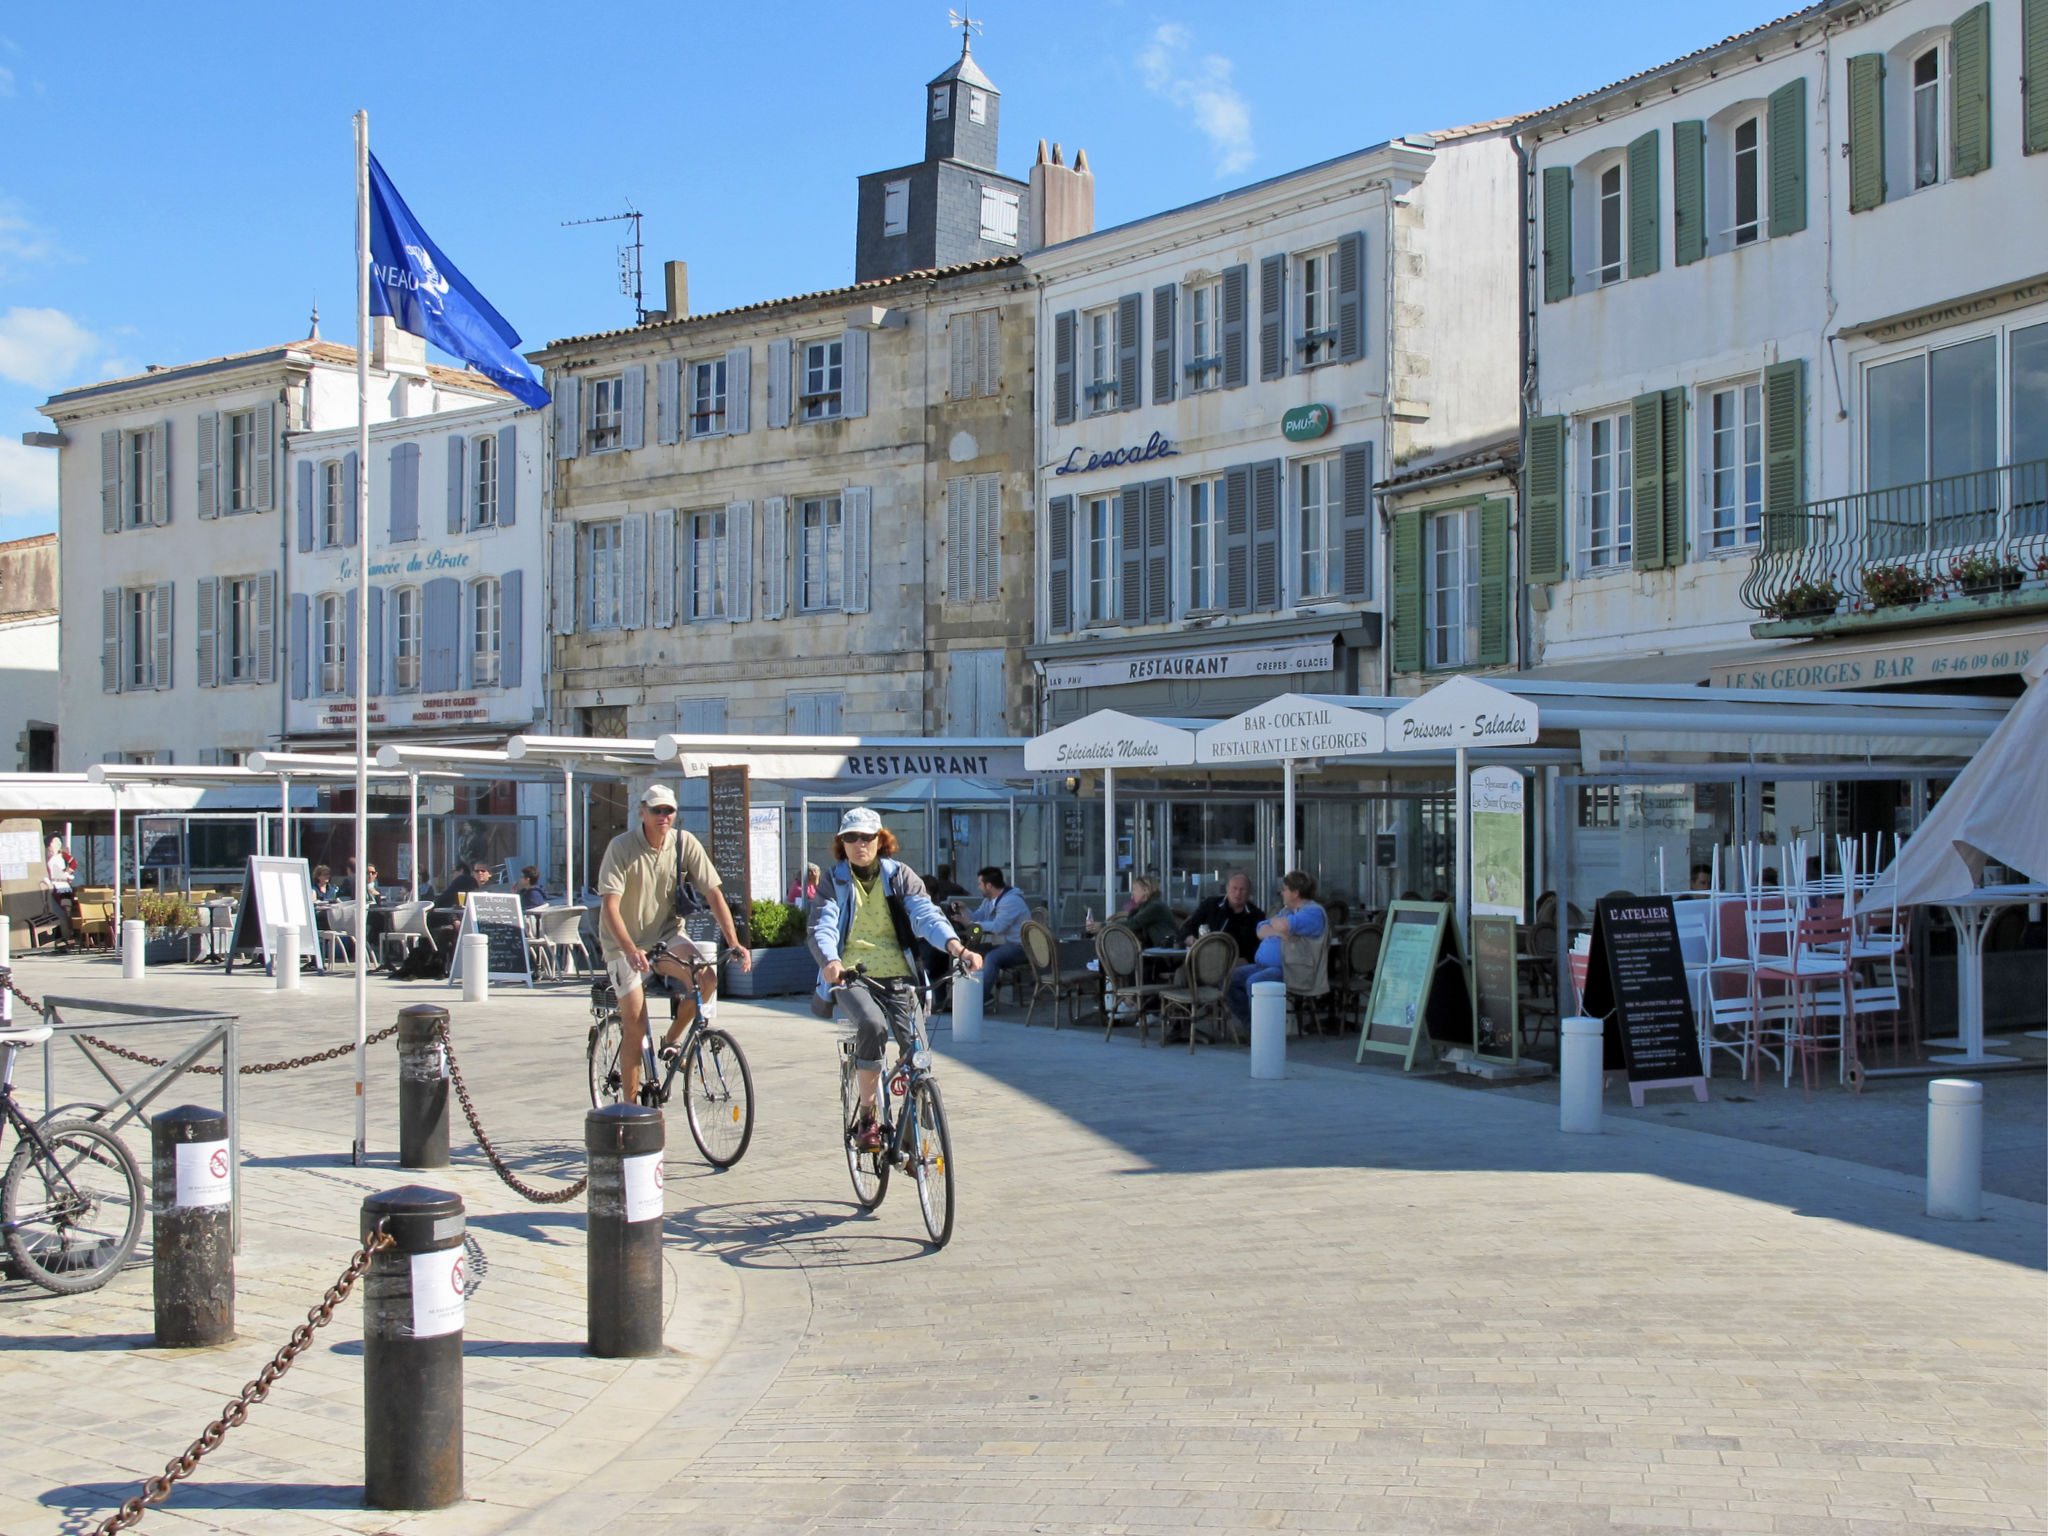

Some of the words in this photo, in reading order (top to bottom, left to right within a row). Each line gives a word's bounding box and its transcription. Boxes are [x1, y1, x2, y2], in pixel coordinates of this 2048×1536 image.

[1285, 417, 1309, 433] PMU
[407, 552, 423, 572] du
[425, 549, 470, 571] Pirate
[1129, 656, 1229, 679] RESTAURANT
[1256, 661, 1287, 671] CREPES
[1296, 657, 1328, 668] GLACES
[1770, 662, 1862, 690] GEORGES
[1873, 656, 1915, 679] BAR
[1931, 658, 1949, 673] 05
[1951, 655, 1968, 672] 46
[1971, 653, 1989, 669] 09
[1991, 652, 2009, 668] 60
[2013, 649, 2029, 666] 18
[1245, 715, 1266, 731] BAR
[1274, 709, 1332, 729] COCKTAIL
[1403, 718, 1454, 742] Poissons
[1472, 713, 1526, 737] Salades
[1057, 740, 1114, 765] Spécialités
[1117, 739, 1159, 758] Moules
[1212, 738, 1282, 757] RESTAURANT
[1284, 736, 1298, 753] LE
[1299, 736, 1310, 751] St
[1312, 731, 1368, 750] GEORGES
[847, 756, 988, 775] RESTAURANT
